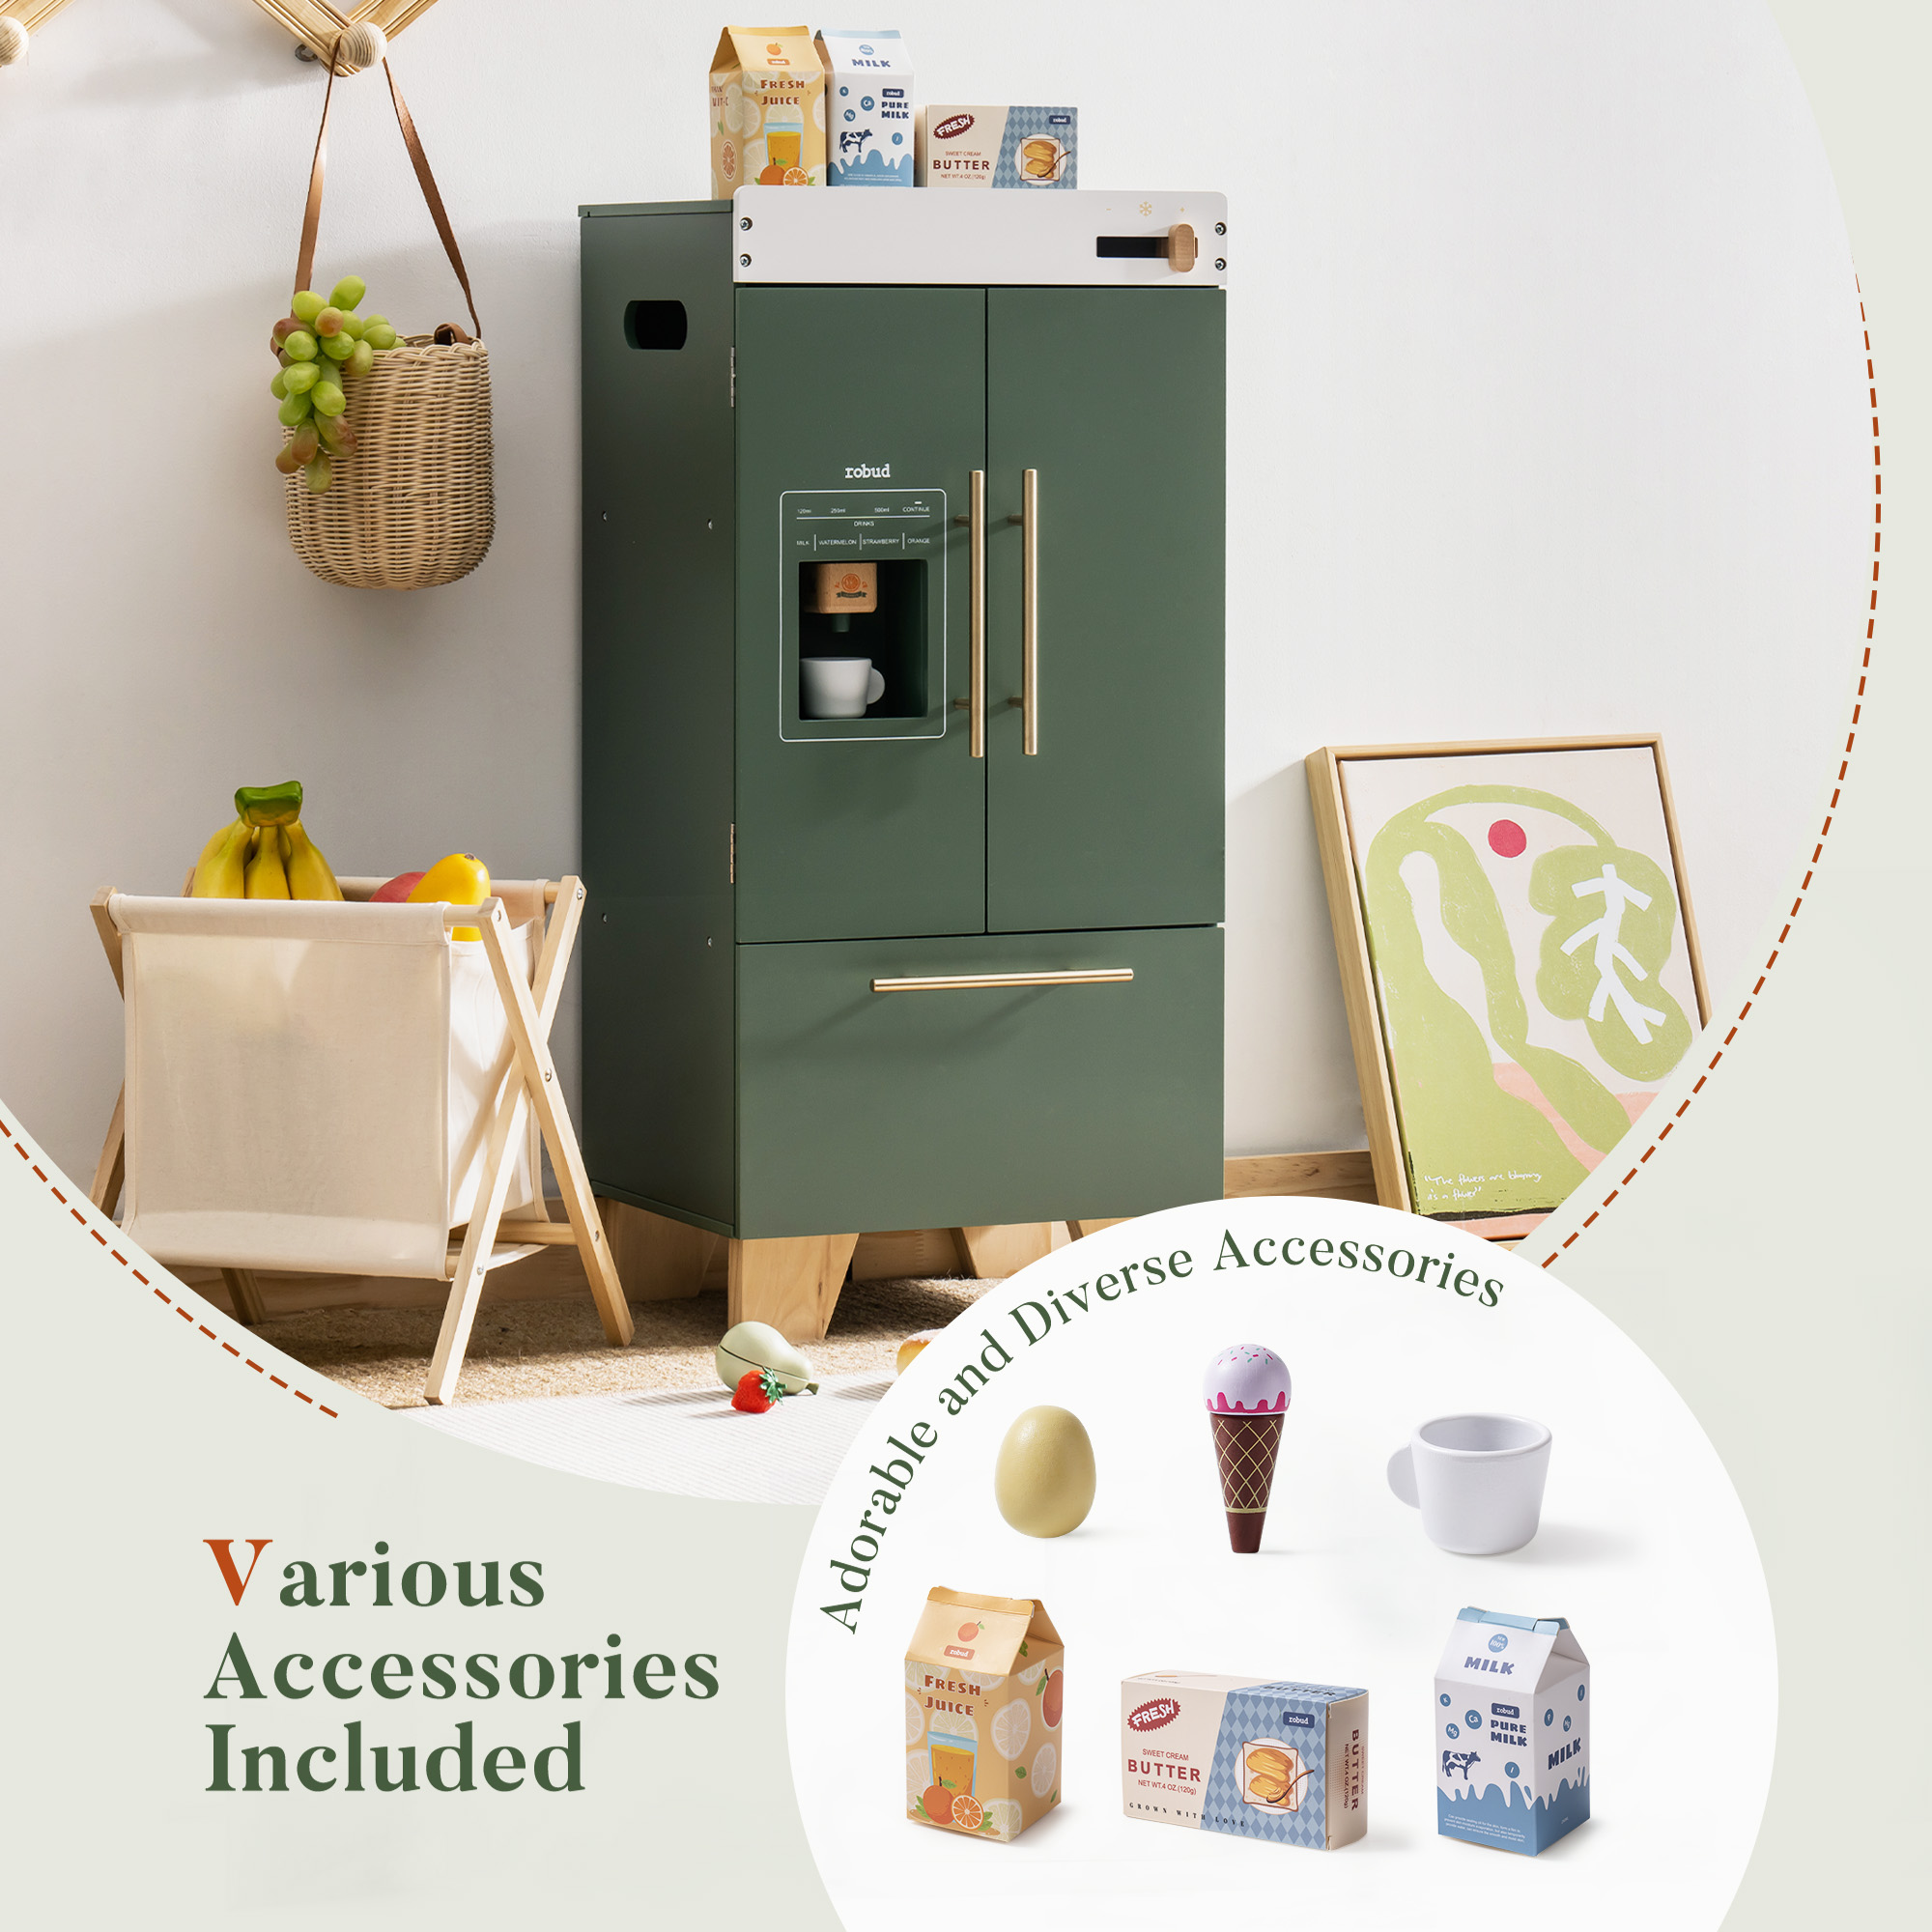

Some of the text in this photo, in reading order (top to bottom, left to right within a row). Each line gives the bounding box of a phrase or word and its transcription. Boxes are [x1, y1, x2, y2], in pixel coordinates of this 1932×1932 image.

[852, 59, 891, 68] MILK
[760, 79, 805, 89] FRESH
[761, 96, 800, 105] JUICE
[936, 114, 971, 136] FRESH
[933, 159, 990, 170] BUTTER
[844, 464, 891, 479] robud
[1463, 1656, 1515, 1675] MILK
[924, 1674, 980, 1696] FRESH
[924, 1696, 975, 1717] JUICE
[1131, 1699, 1175, 1727] FRESH
[1496, 1707, 1515, 1716] robud
[1289, 1716, 1309, 1725] robud
[1468, 1715, 1479, 1723] Ca
[1491, 1719, 1527, 1734] PURE
[1447, 1727, 1458, 1737] Mg
[1491, 1731, 1528, 1747] MILK
[1142, 1747, 1189, 1761] SWEET CREAM
[1548, 1737, 1581, 1771] MILK
[1128, 1758, 1202, 1782] BUTTER
[1138, 1778, 1151, 1788] NET
[1128, 1802, 1245, 1828] GROWN WITH LOVE
